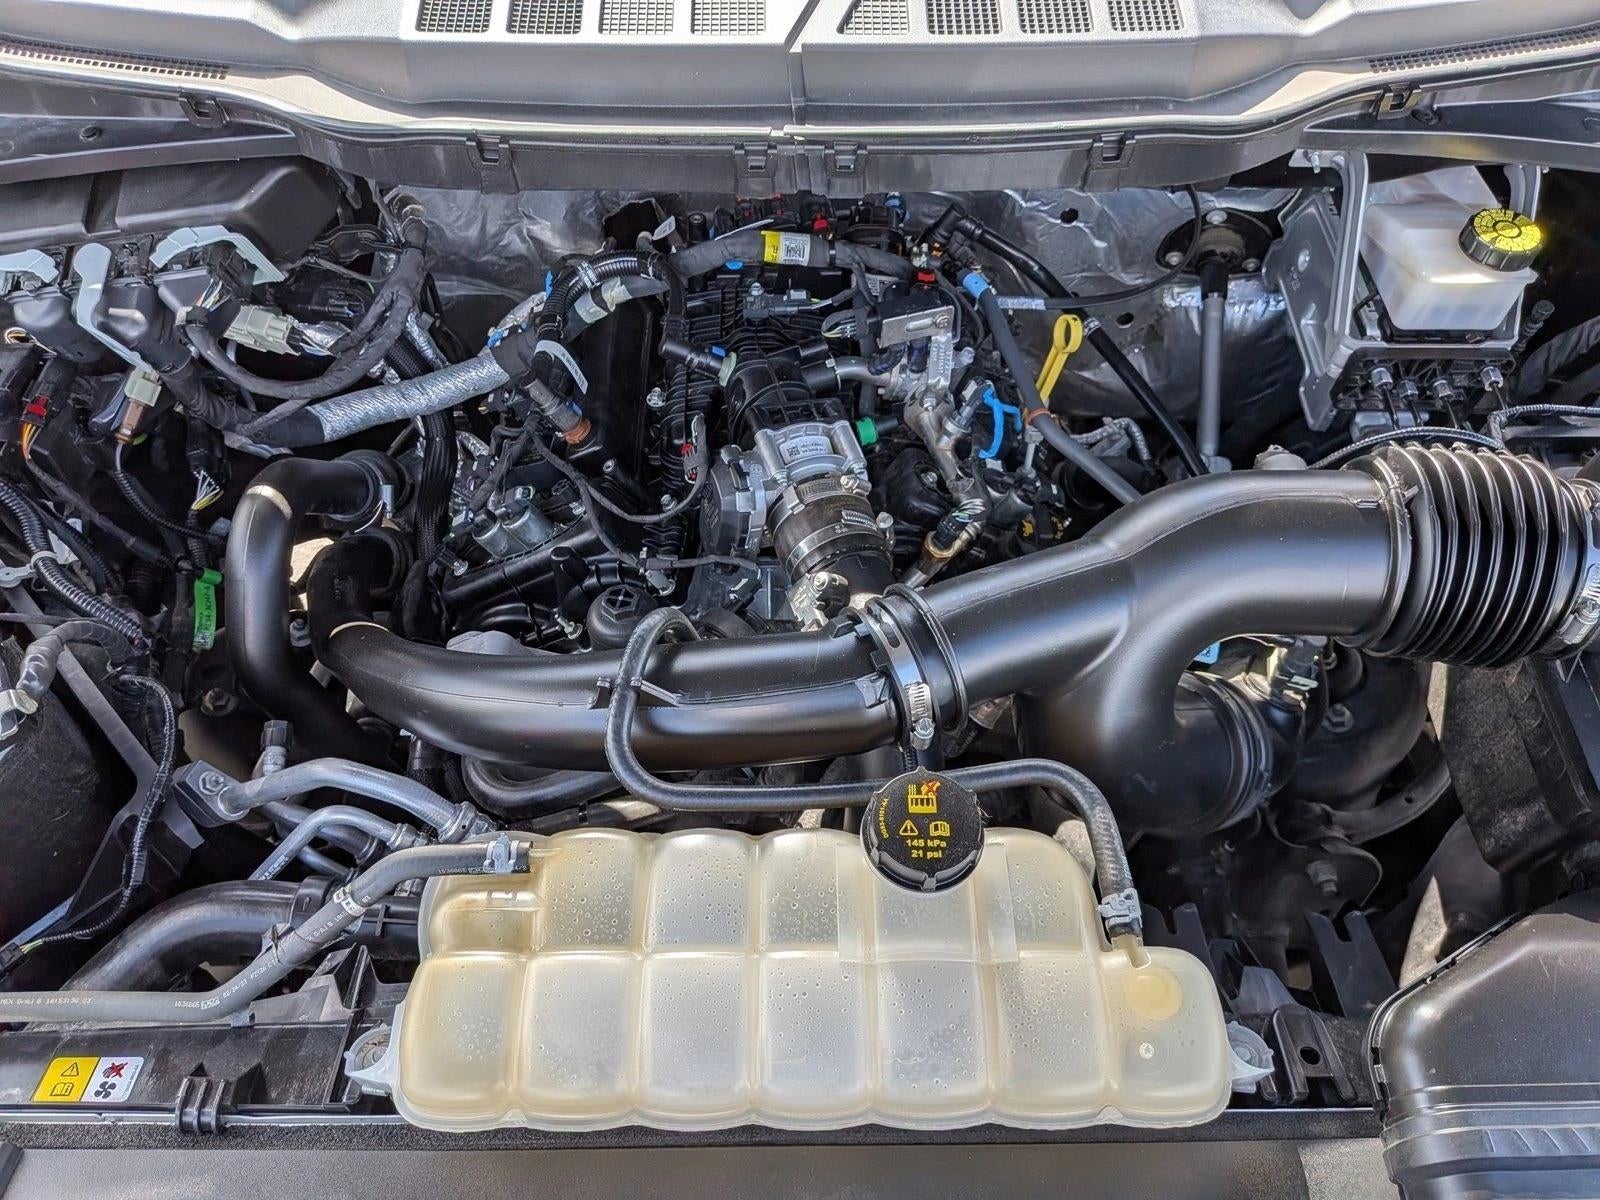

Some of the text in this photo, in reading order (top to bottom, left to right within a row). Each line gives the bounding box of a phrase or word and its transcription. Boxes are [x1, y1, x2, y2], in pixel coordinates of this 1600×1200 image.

[905, 839, 947, 847] 145 kPa
[927, 850, 943, 859] psi
